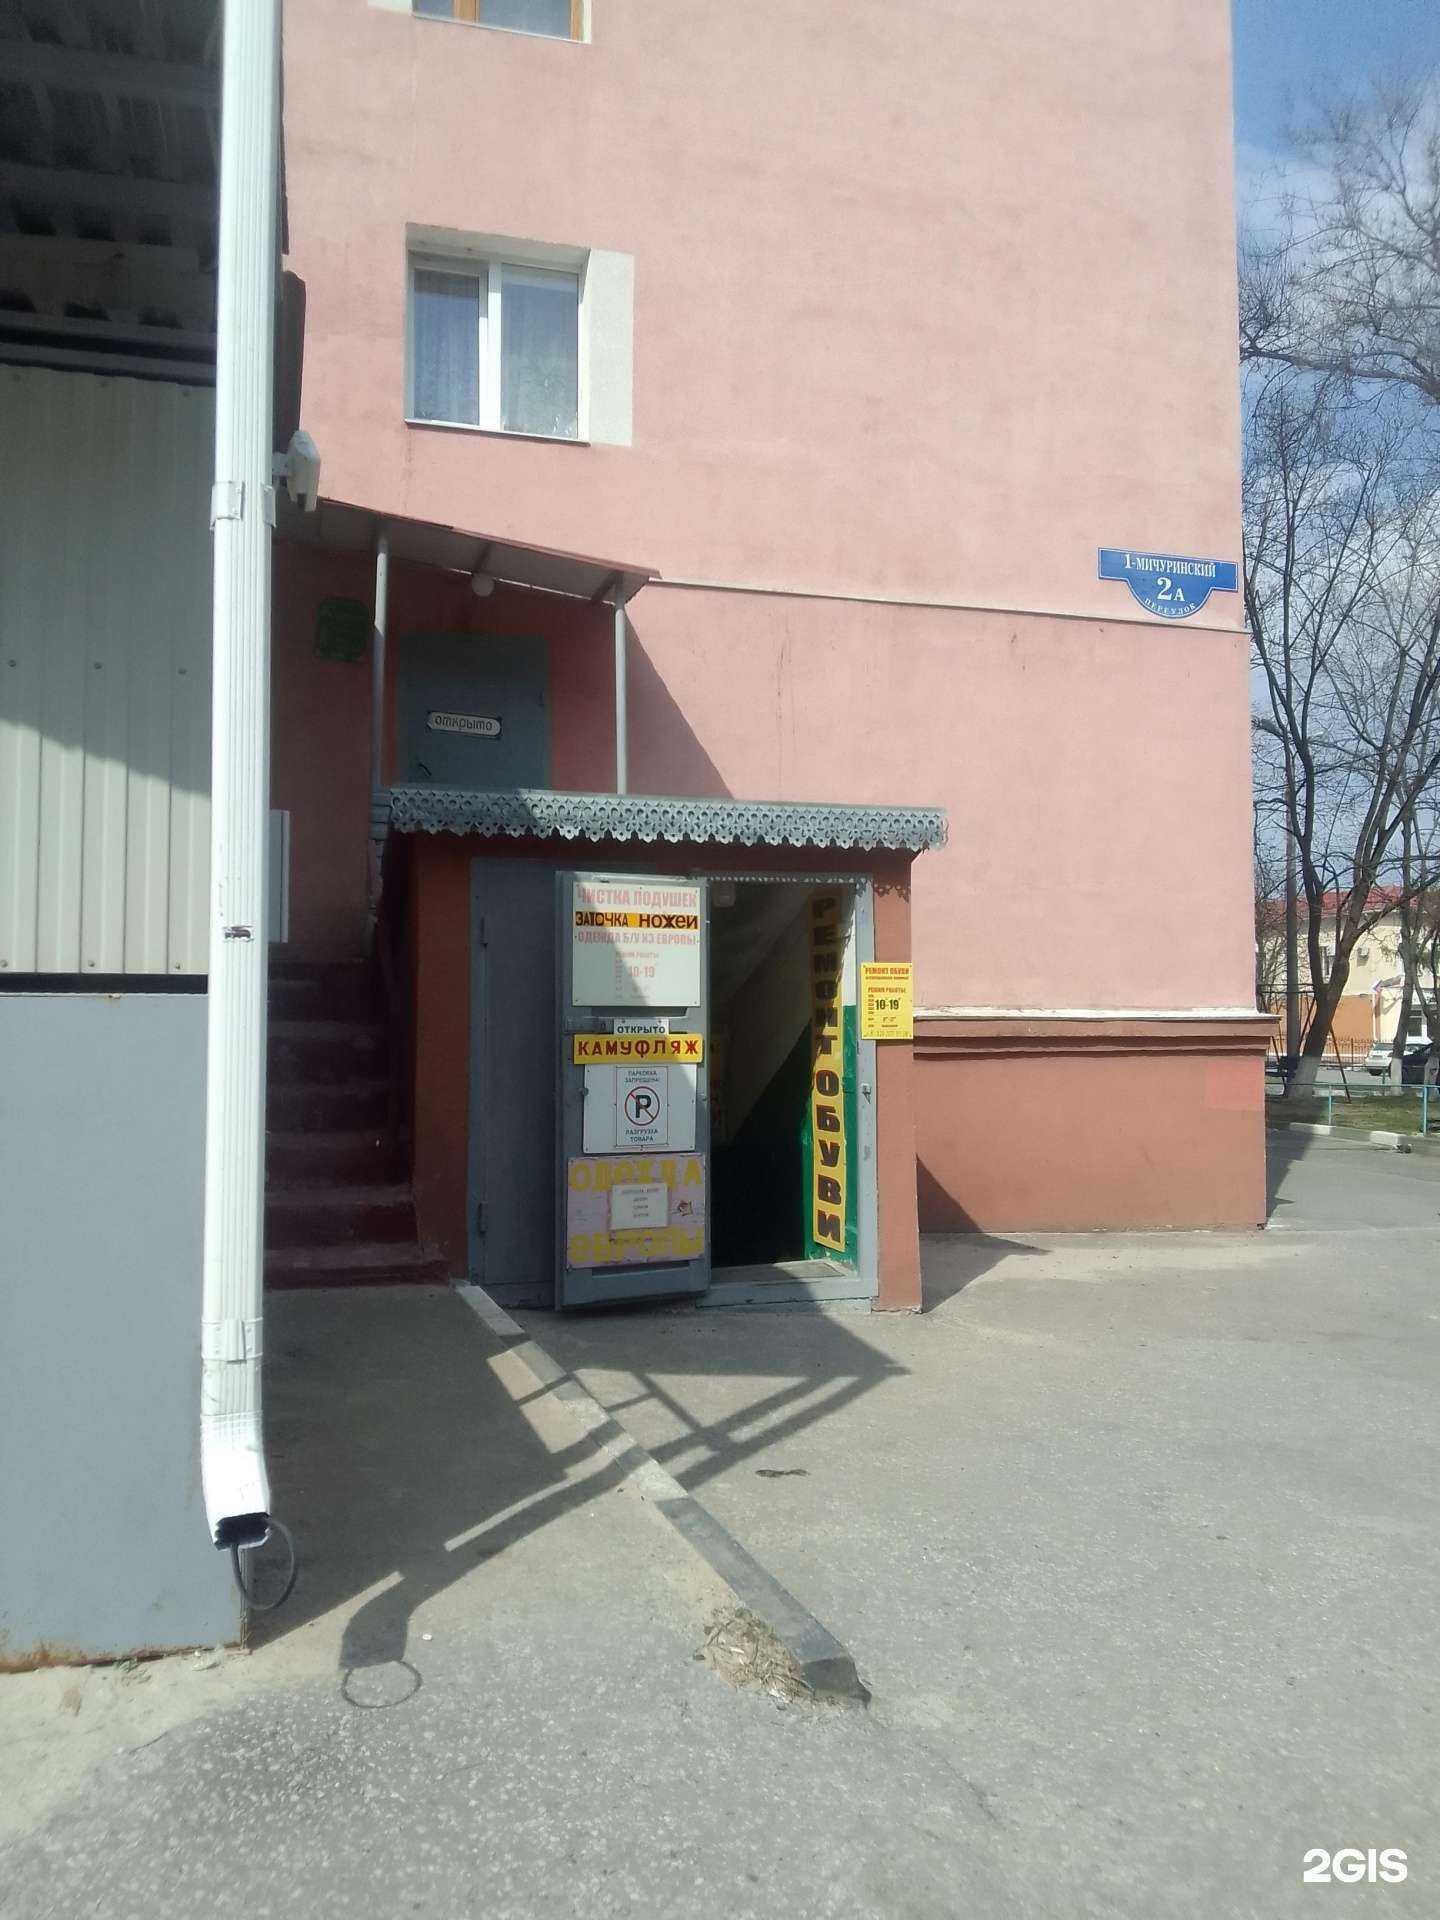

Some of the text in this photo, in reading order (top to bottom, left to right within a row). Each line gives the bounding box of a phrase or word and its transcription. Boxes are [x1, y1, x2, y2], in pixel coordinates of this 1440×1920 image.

[1124, 553, 1216, 577] 1-МИЧУРИНСКИЙ
[434, 716, 493, 731] открыто
[577, 886, 697, 909] ЧИСТКА ПОДУШЕК
[575, 911, 628, 927] ЗАТОЧКА
[875, 999, 900, 1010] 10-19
[617, 1025, 666, 1034] ОТКРЫТО
[578, 1039, 699, 1058] КАМУФЛЯЖ
[816, 1069, 842, 1243] ОБУВИ
